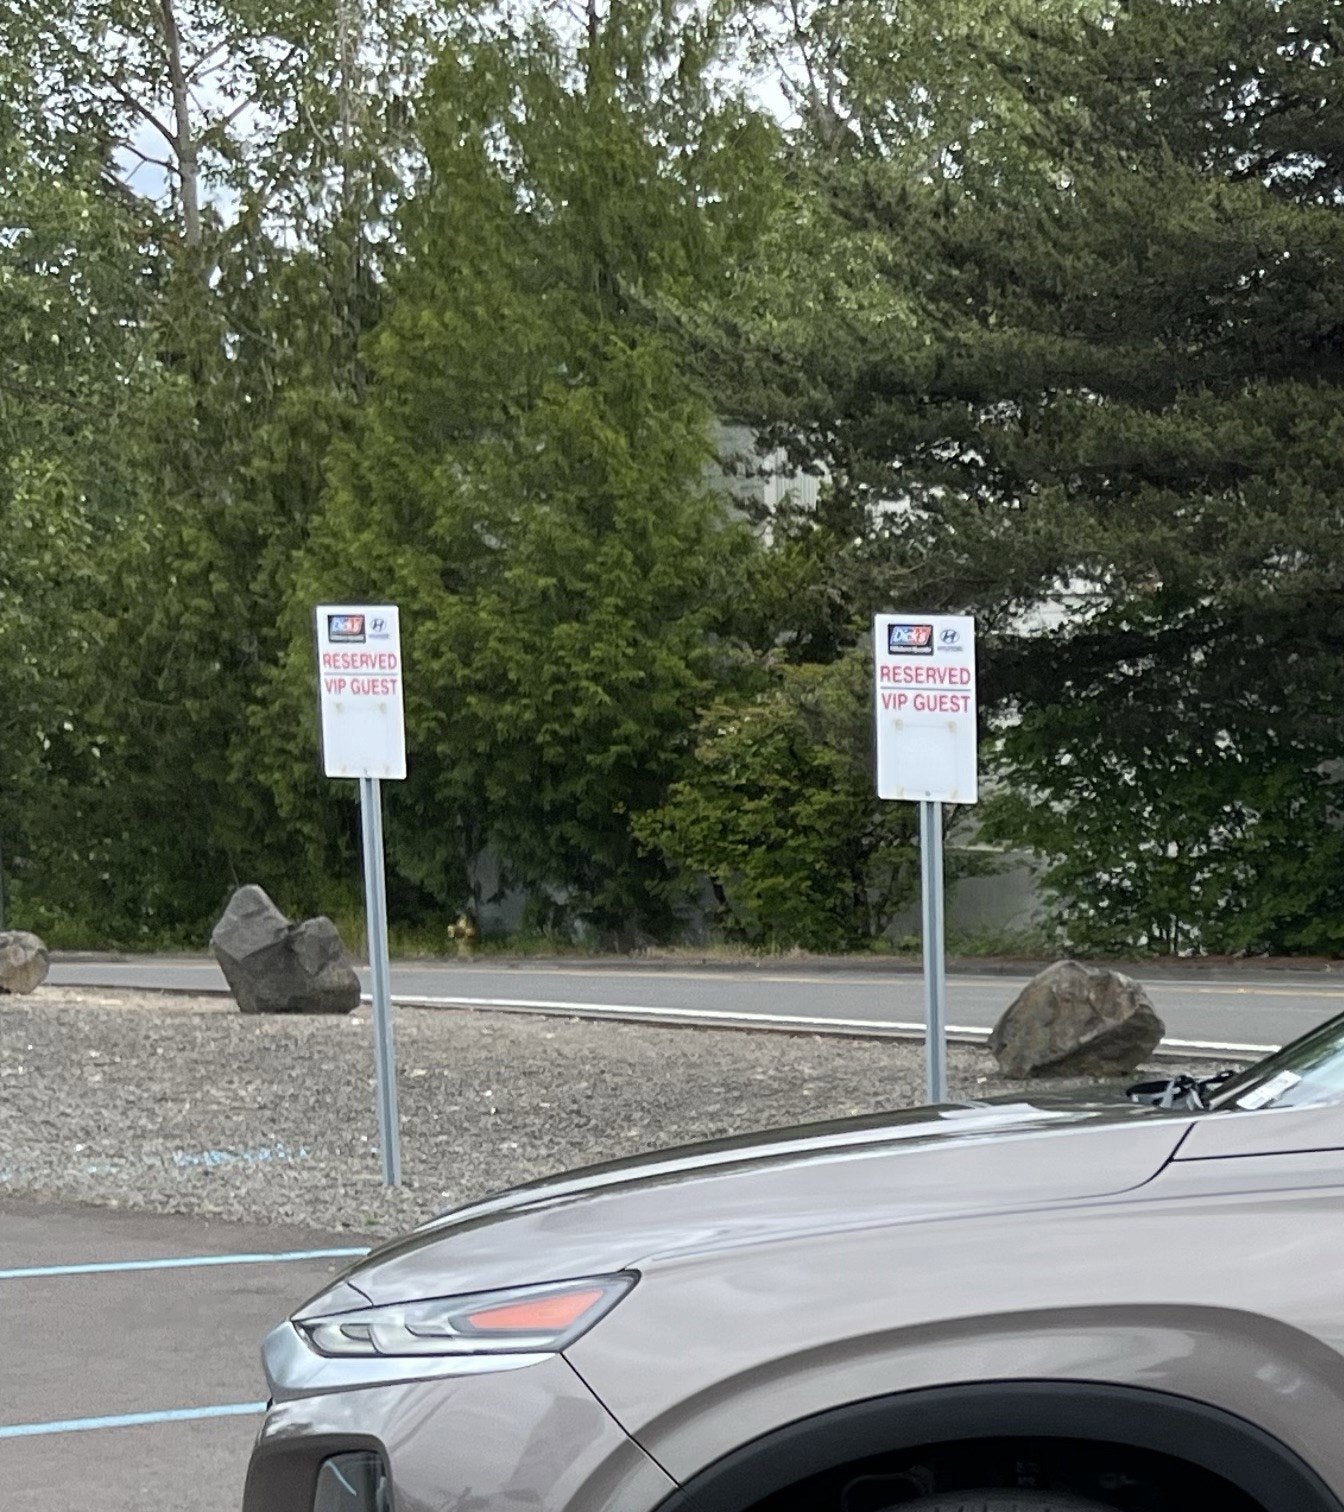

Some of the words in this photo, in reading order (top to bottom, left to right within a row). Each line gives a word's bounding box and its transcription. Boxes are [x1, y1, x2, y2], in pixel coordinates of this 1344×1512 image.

[322, 652, 398, 670] RESERVED
[880, 665, 971, 685] RESERVED
[325, 678, 346, 695] VIP
[351, 678, 398, 696] GUEST
[882, 693, 908, 710] VIP
[913, 694, 971, 713] GUEST
